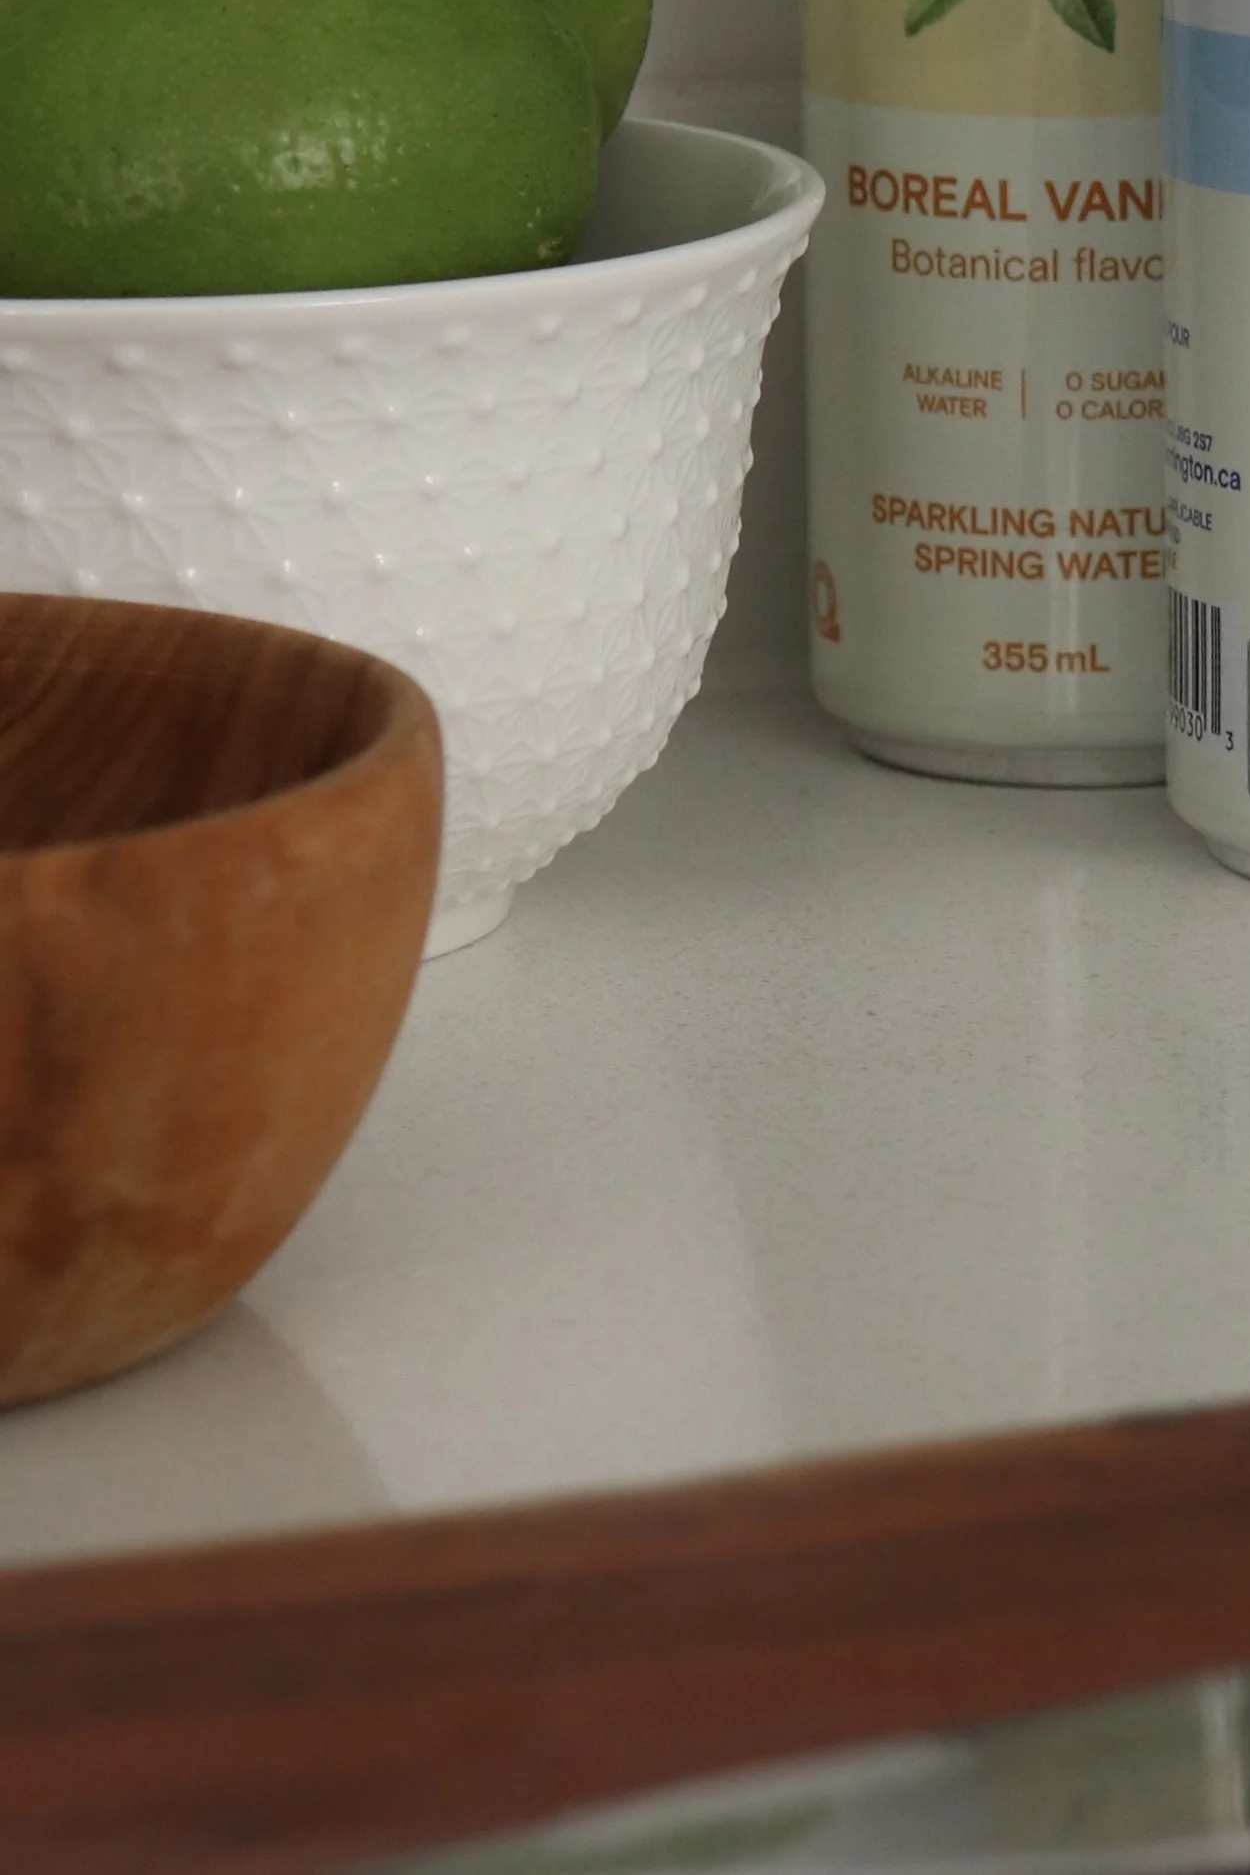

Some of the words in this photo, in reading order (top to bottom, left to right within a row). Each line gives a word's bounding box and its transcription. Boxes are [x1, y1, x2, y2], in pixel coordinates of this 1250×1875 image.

[847, 165, 1027, 221] BOREAL
[891, 237, 1059, 282] Botanical
[902, 362, 1002, 392] ALKALINE
[916, 393, 987, 418] WATER
[1081, 400, 1165, 421] CALOR
[872, 493, 1056, 538] SPARKLING
[1069, 508, 1166, 538] NATU
[915, 542, 1045, 580] SPRING
[1057, 549, 1166, 581] WATE
[982, 641, 1049, 673] 355
[1056, 643, 1111, 673] mL
[1225, 731, 1234, 751] 3
